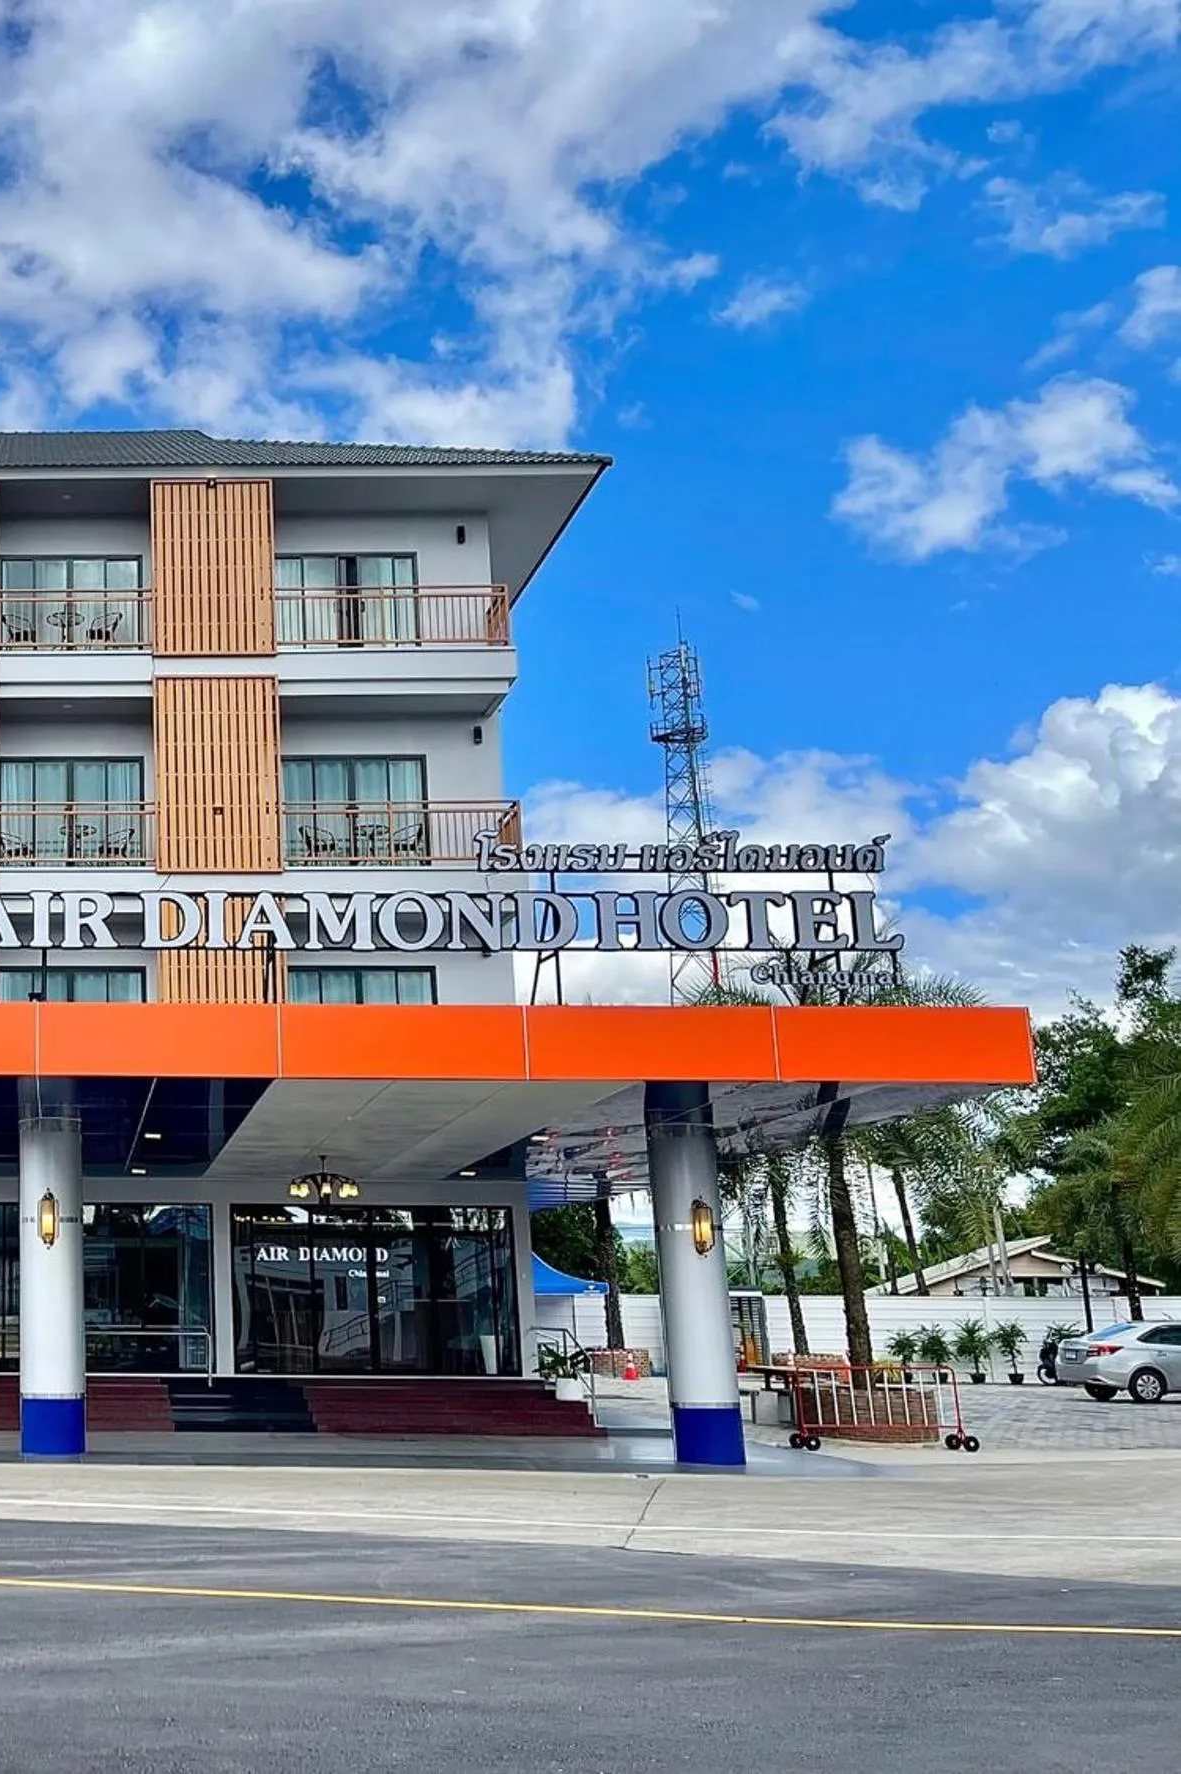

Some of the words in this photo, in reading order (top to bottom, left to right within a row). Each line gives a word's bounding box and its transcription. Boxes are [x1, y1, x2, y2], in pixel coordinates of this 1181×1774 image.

[474, 829, 626, 871] โรงแรม
[641, 830, 891, 871] แอร์ไดมอนด์
[139, 889, 579, 951] DIAMOND
[593, 890, 905, 951] HOTEL
[750, 961, 902, 990] Chiangmai
[256, 1246, 290, 1262] AIR
